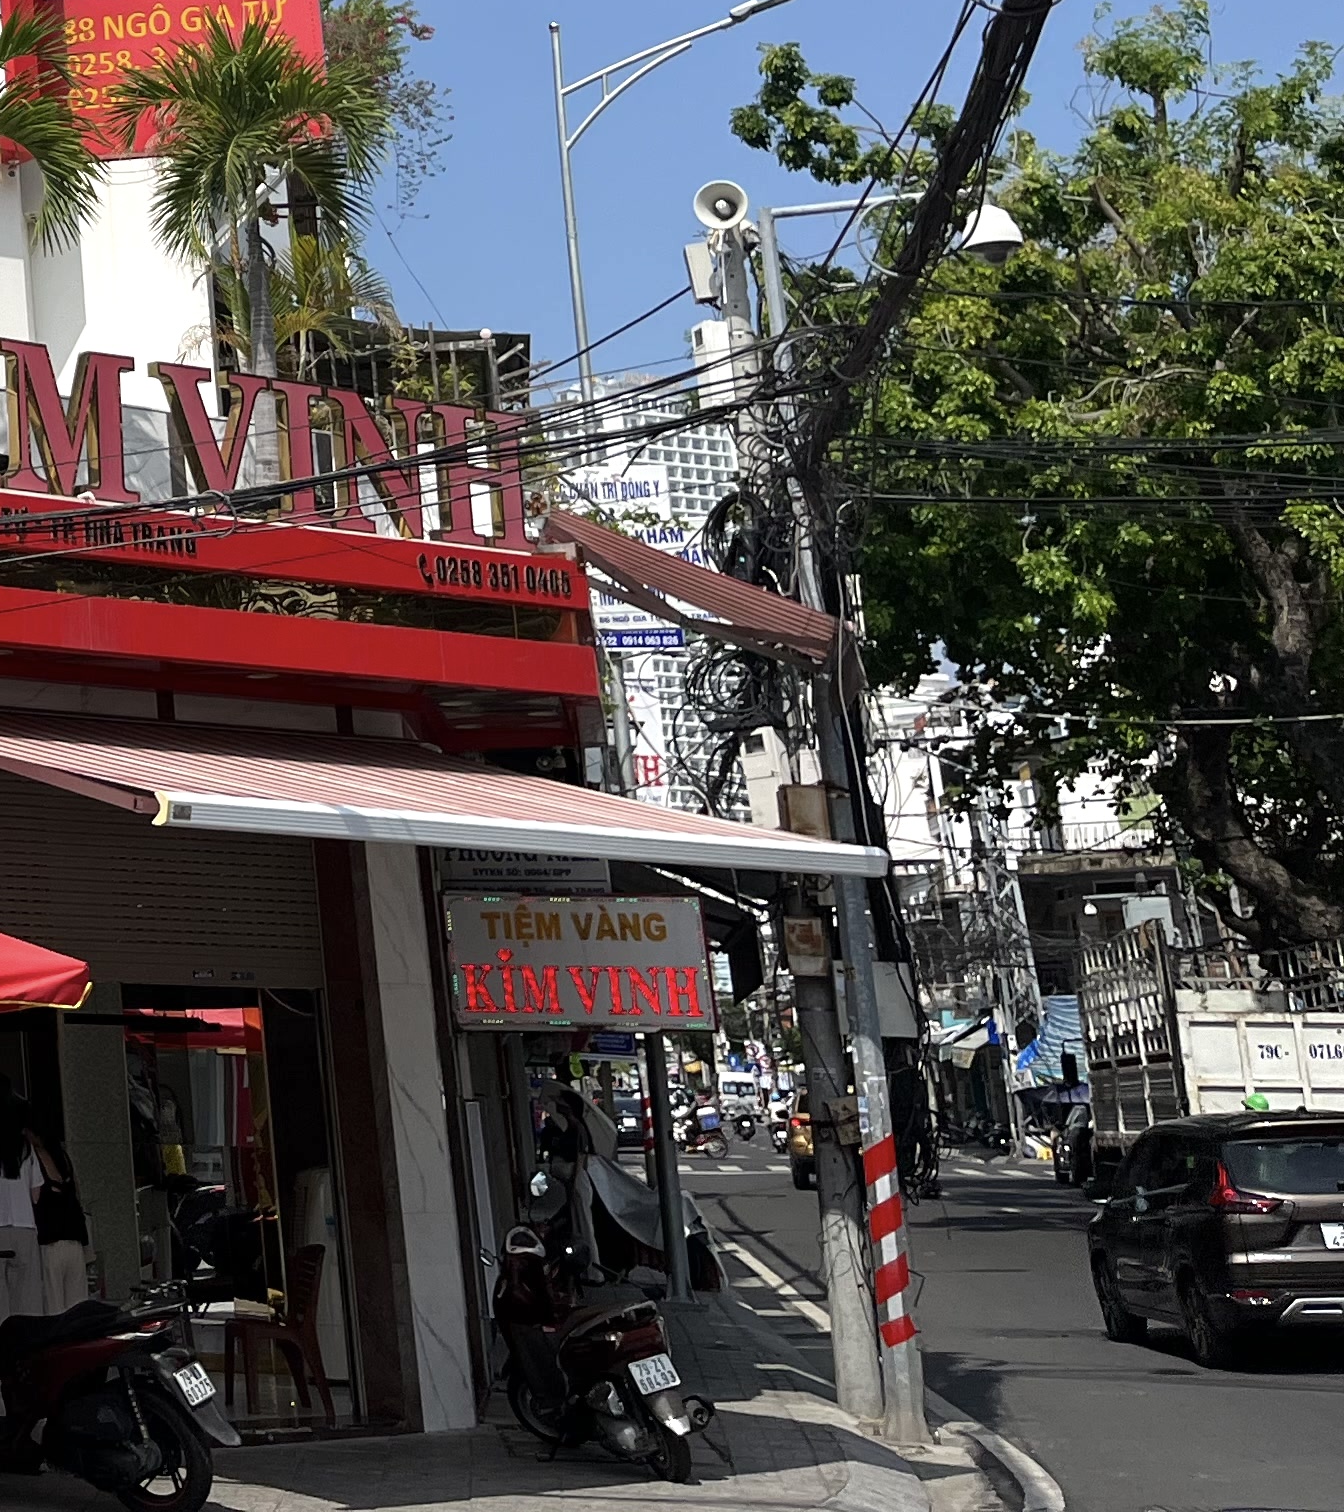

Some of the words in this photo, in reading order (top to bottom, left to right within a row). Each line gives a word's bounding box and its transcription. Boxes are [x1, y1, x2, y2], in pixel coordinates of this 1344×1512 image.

[103, 3, 171, 41] NGÔ
[180, 4, 235, 32] GIA
[148, 360, 540, 554] VINH
[84, 517, 124, 547] NHA
[130, 521, 198, 555] TRANG
[435, 555, 483, 587] 0258
[488, 561, 520, 593] 351
[525, 565, 572, 599] 0405
[480, 904, 561, 948] TIỆM
[570, 904, 667, 942] VÀNG
[566, 966, 703, 1017] VINH
